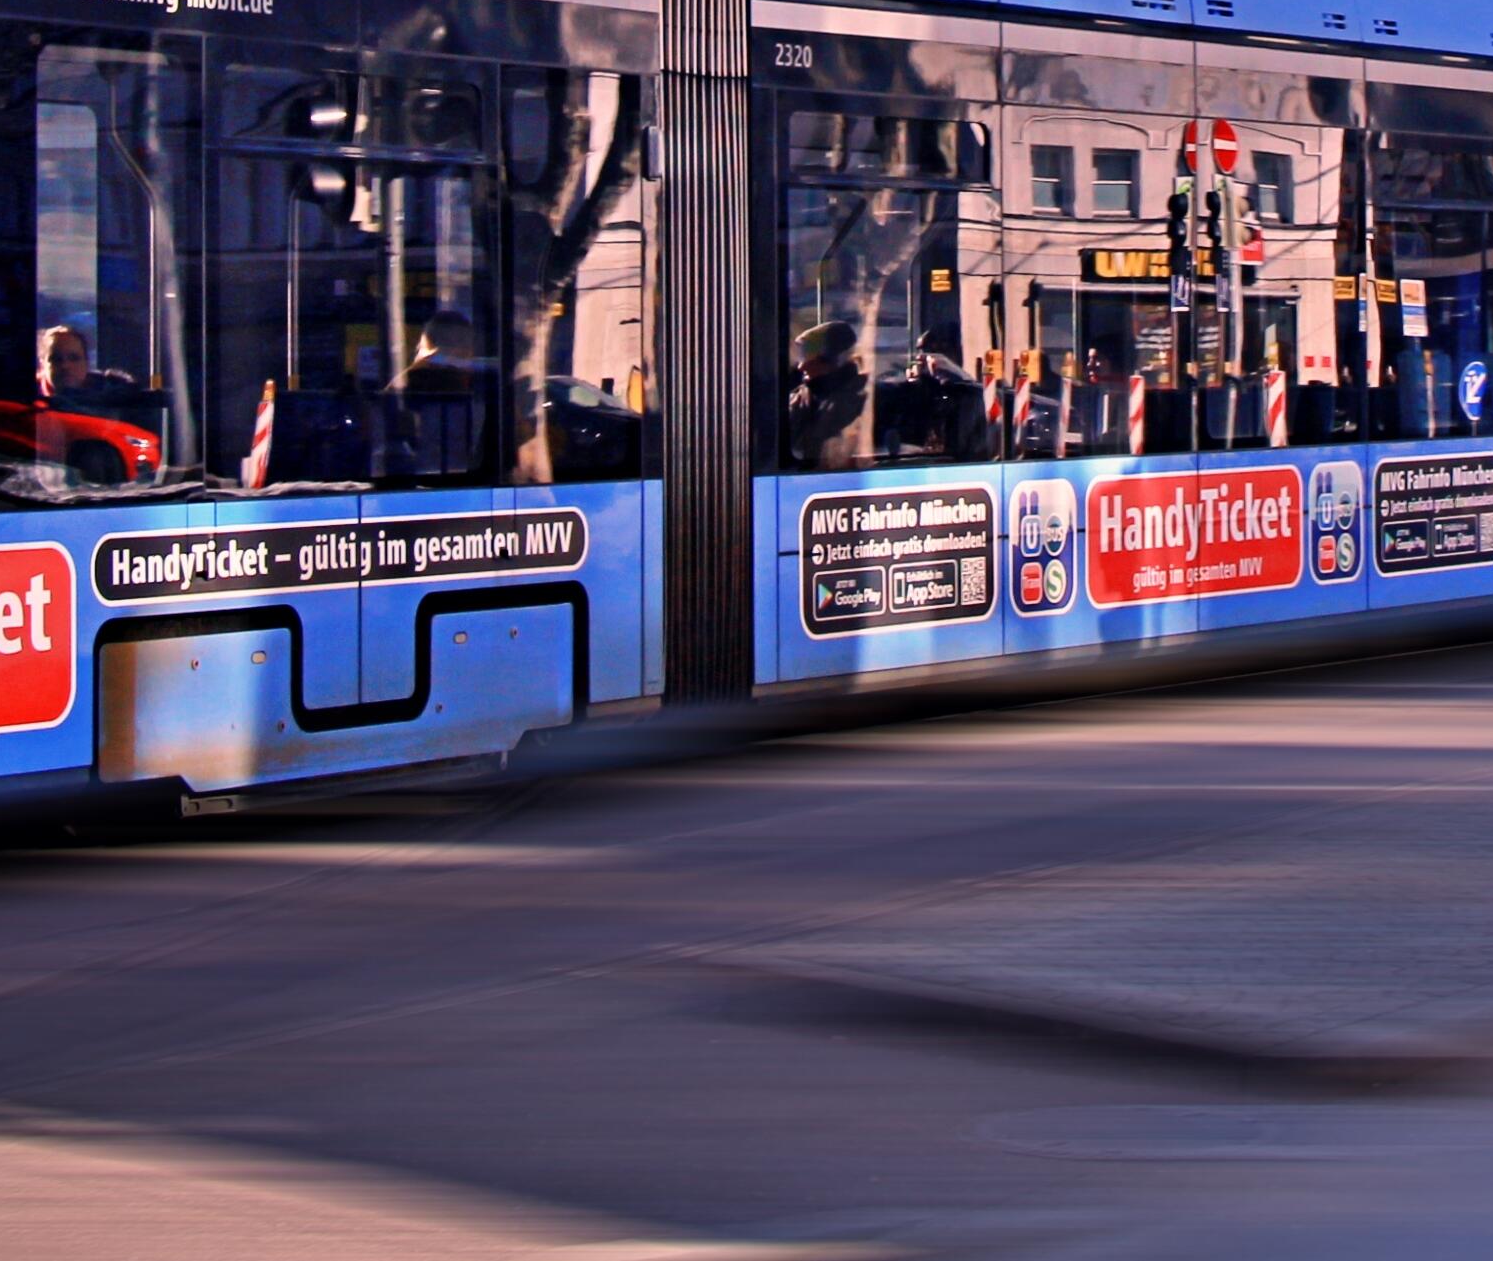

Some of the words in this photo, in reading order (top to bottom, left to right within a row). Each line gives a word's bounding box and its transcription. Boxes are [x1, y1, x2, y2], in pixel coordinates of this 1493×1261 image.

[775, 43, 813, 68] 2320
[811, 508, 848, 535] MVG
[852, 502, 917, 532] Fahrinfo
[919, 497, 986, 526] München
[1099, 482, 1292, 561] HandyTicket
[112, 539, 268, 590] HandyTicket
[299, 529, 372, 580] gültig
[377, 532, 406, 567] im
[414, 527, 519, 572] gesamten
[526, 521, 573, 555] MVV
[826, 543, 852, 565] Jetzt
[853, 538, 892, 559] einfach
[893, 536, 923, 560] gratis
[1133, 567, 1167, 593] gültig
[1169, 565, 1183, 585] im
[1186, 563, 1236, 586] gesamten
[1239, 557, 1263, 577] MVV
[834, 590, 864, 608] Google
[906, 584, 927, 606] App
[927, 581, 954, 600] Store
